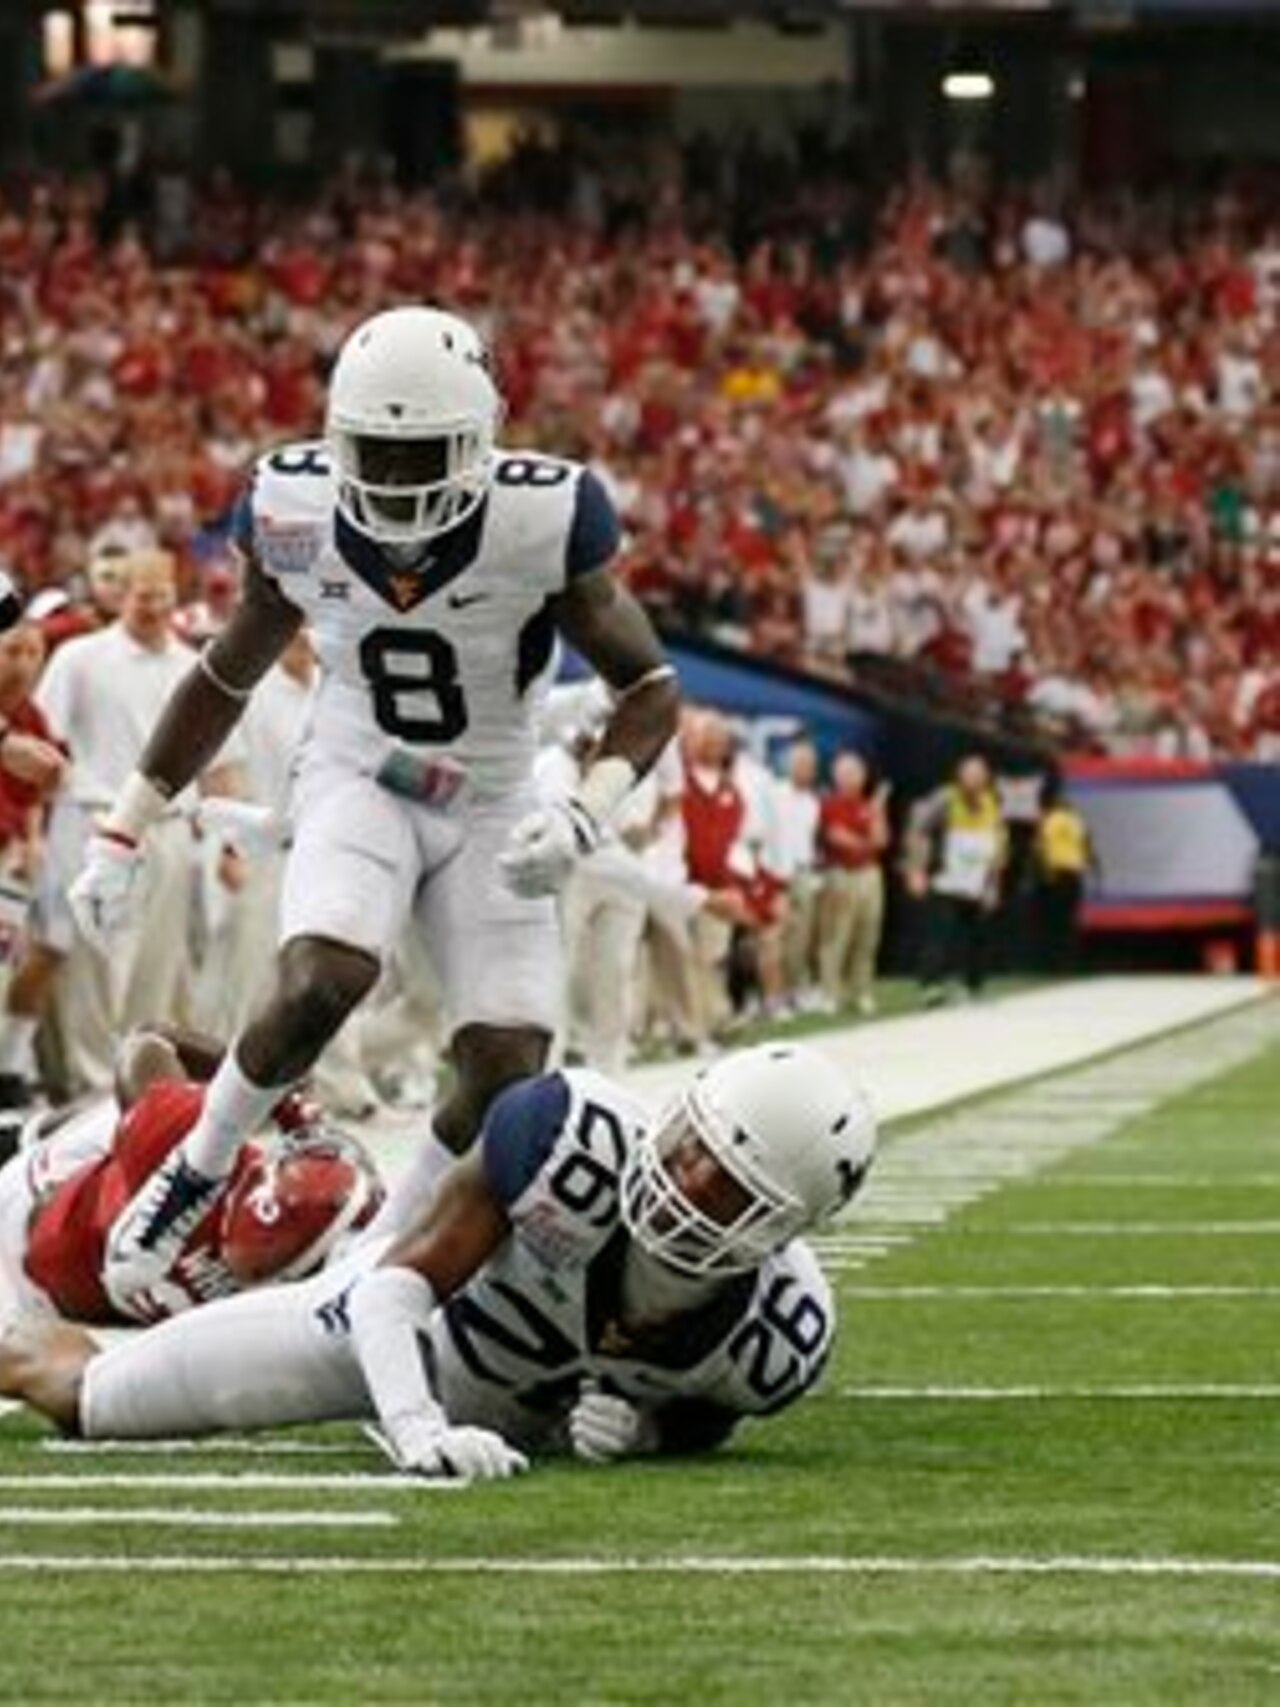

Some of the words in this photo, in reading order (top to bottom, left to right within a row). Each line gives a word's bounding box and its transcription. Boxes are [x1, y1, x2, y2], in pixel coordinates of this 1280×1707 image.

[495, 458, 570, 488] 8
[358, 625, 468, 745] 8
[727, 1275, 826, 1399] 26
